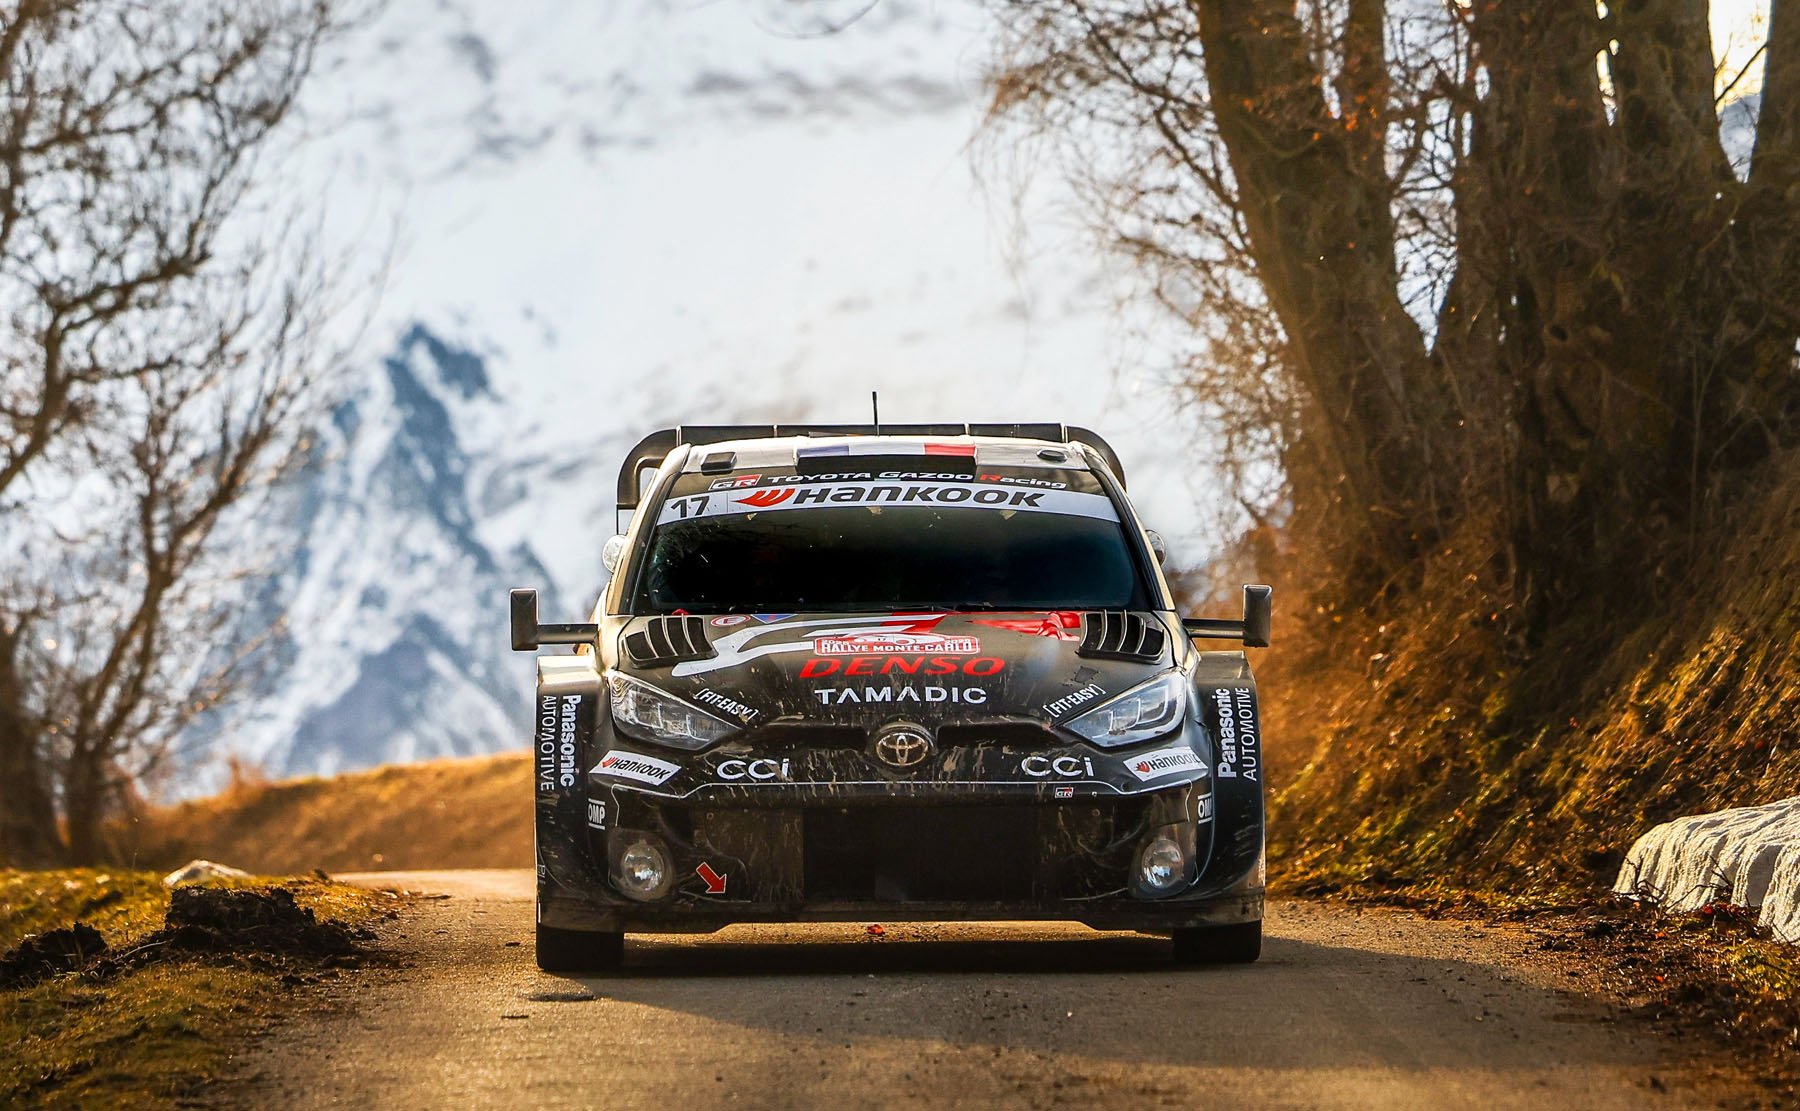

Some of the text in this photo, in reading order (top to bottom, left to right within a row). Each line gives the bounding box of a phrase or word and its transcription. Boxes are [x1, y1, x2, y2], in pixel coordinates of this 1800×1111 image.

[711, 471, 1067, 490] GR TOYOTA GAZOO Racing
[671, 495, 710, 518] 17
[821, 641, 972, 653] RALLYE MONTE-CARLO
[799, 656, 1006, 678] DENSO
[814, 686, 987, 705] TAMADIC
[540, 695, 557, 791] AUTOMOTIVE
[560, 694, 582, 787] Panasonic
[1212, 688, 1237, 778] Panasonic
[1235, 687, 1257, 781] AUTOMOTIVE
[588, 803, 605, 824] OMP
[1197, 799, 1212, 819] OM
